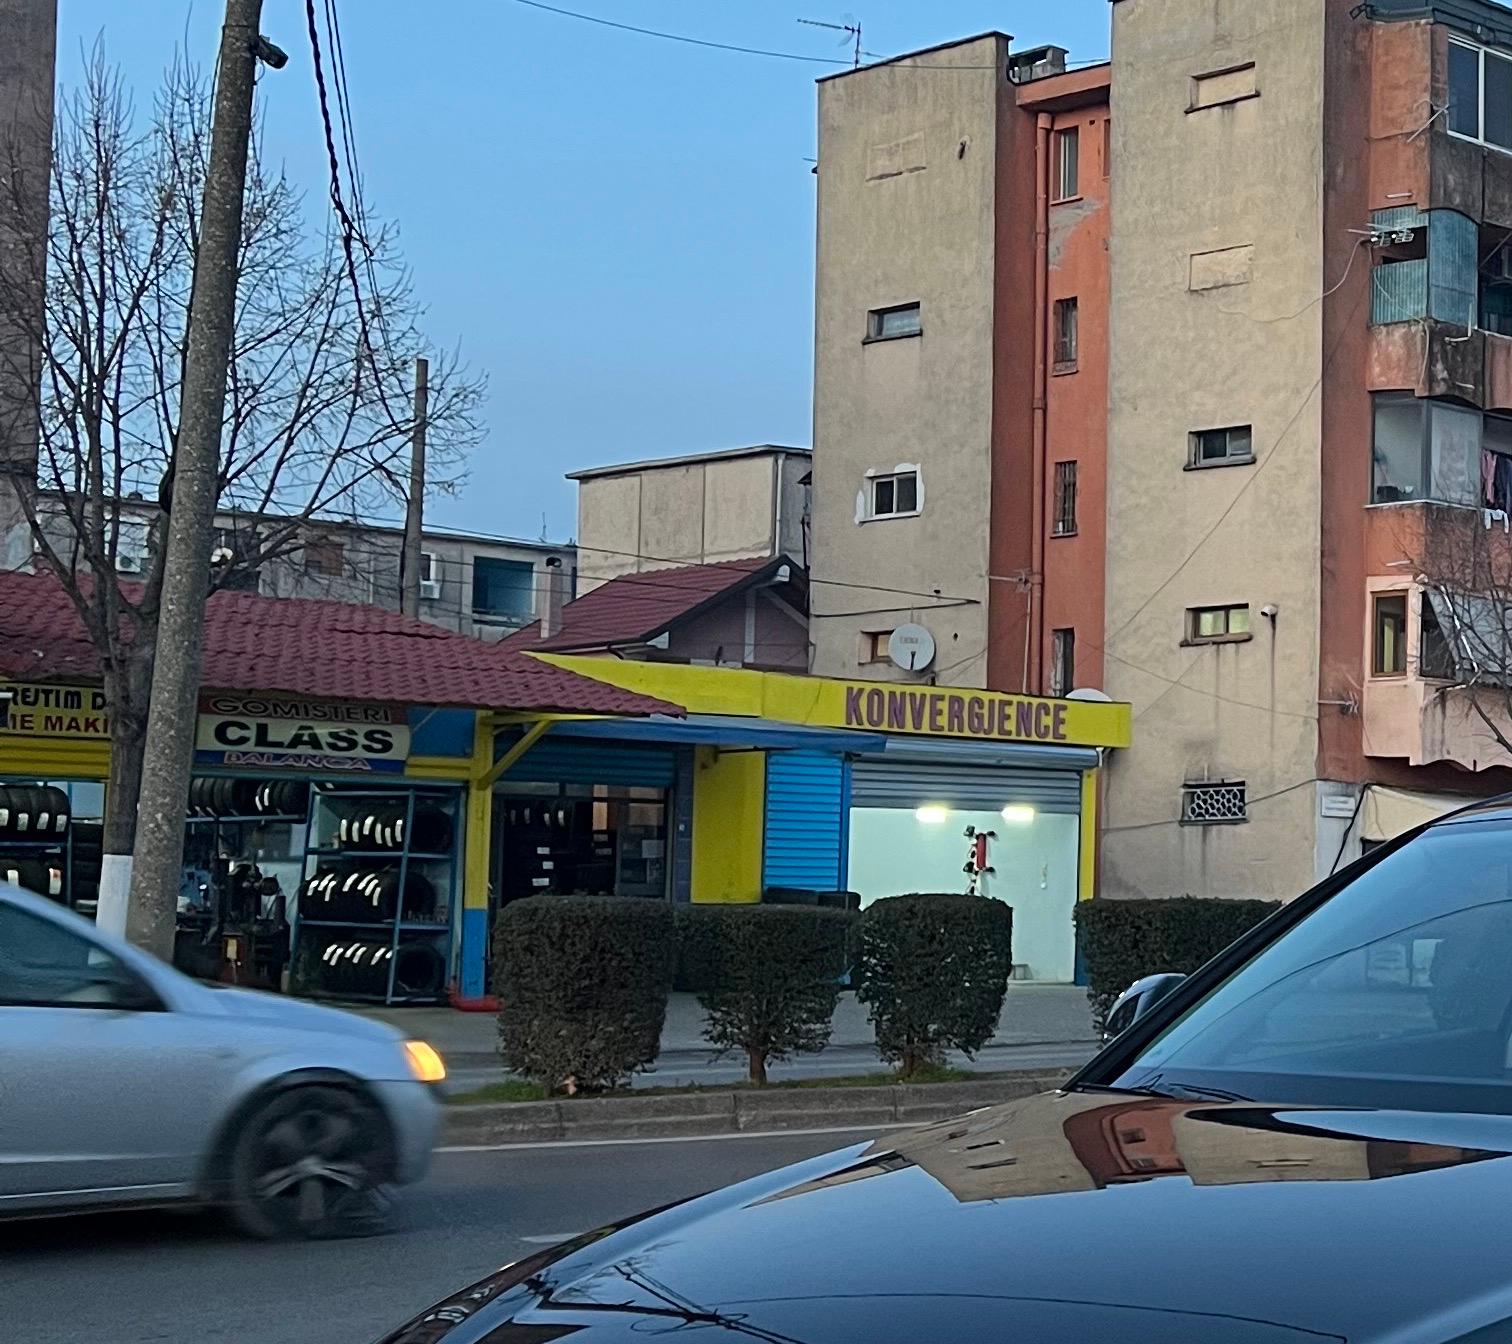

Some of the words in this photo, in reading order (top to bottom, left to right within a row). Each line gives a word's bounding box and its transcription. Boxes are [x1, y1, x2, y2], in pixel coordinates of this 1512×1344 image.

[91, 691, 107, 710] D
[210, 698, 391, 723] GOMISTERI
[845, 686, 1068, 740] KONVERGJENCE
[44, 715, 109, 734] MAKI
[214, 720, 394, 754] CLASS
